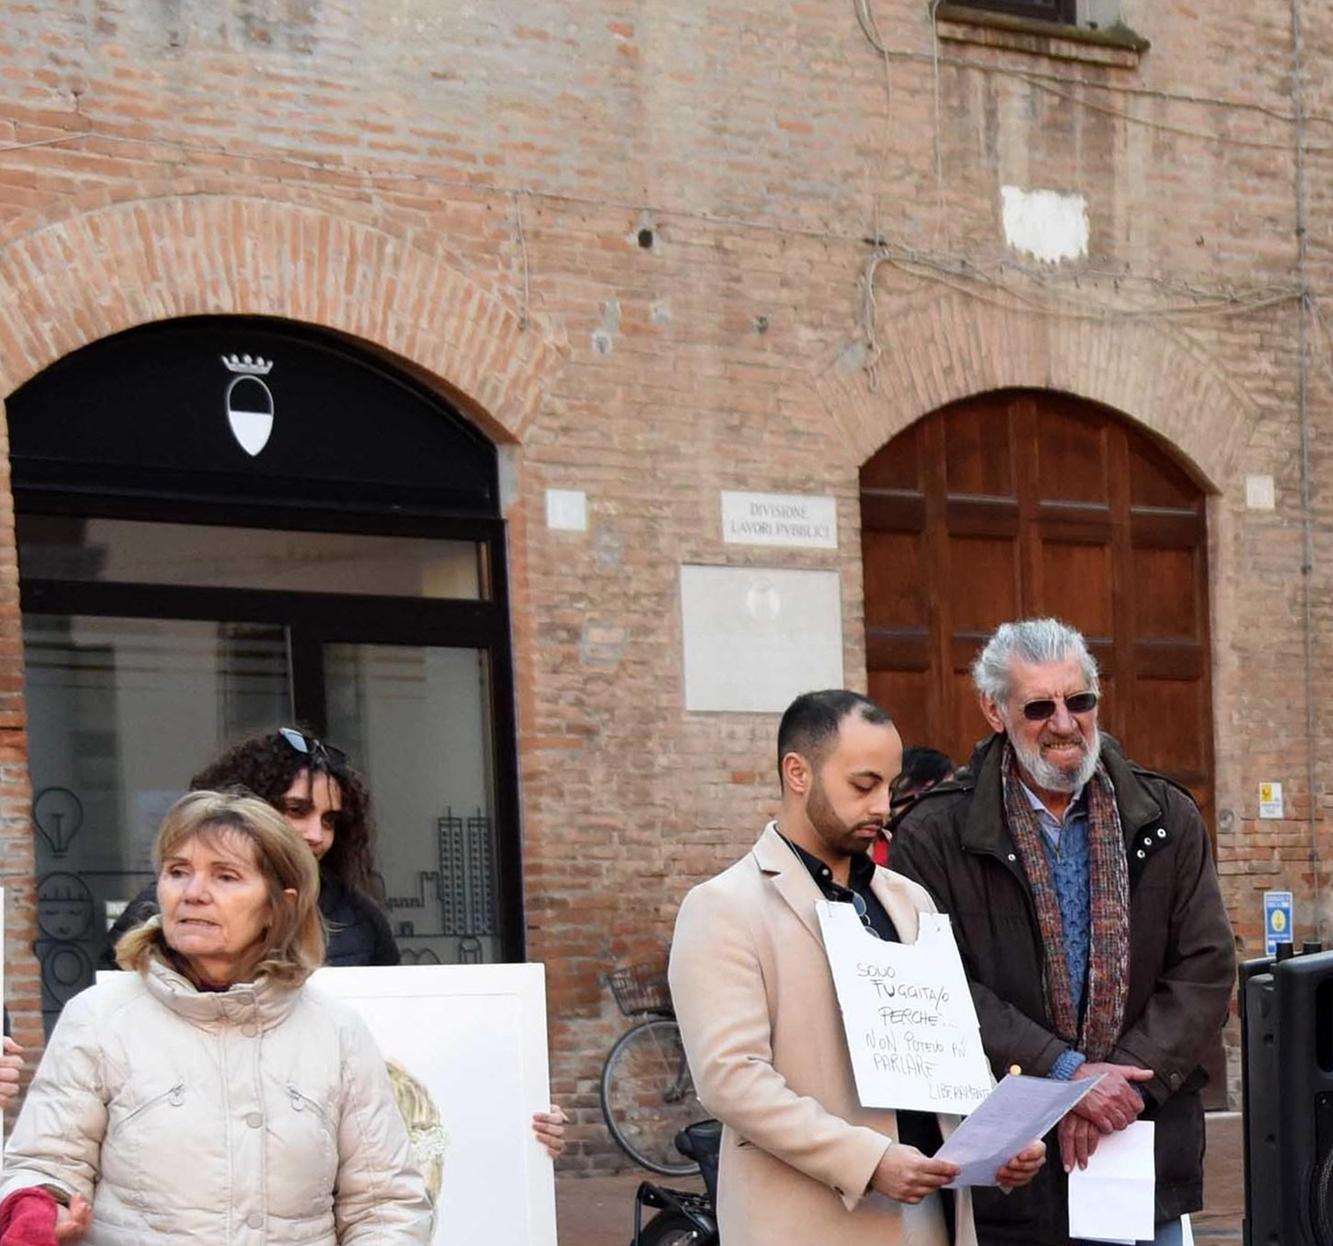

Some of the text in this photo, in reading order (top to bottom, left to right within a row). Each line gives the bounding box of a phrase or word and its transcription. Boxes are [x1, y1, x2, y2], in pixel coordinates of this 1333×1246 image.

[750, 502, 807, 519] DIVISIONE
[731, 519, 772, 537] LAVORI
[866, 1029, 897, 1052] NON
[874, 1053, 938, 1078] PARLARE
